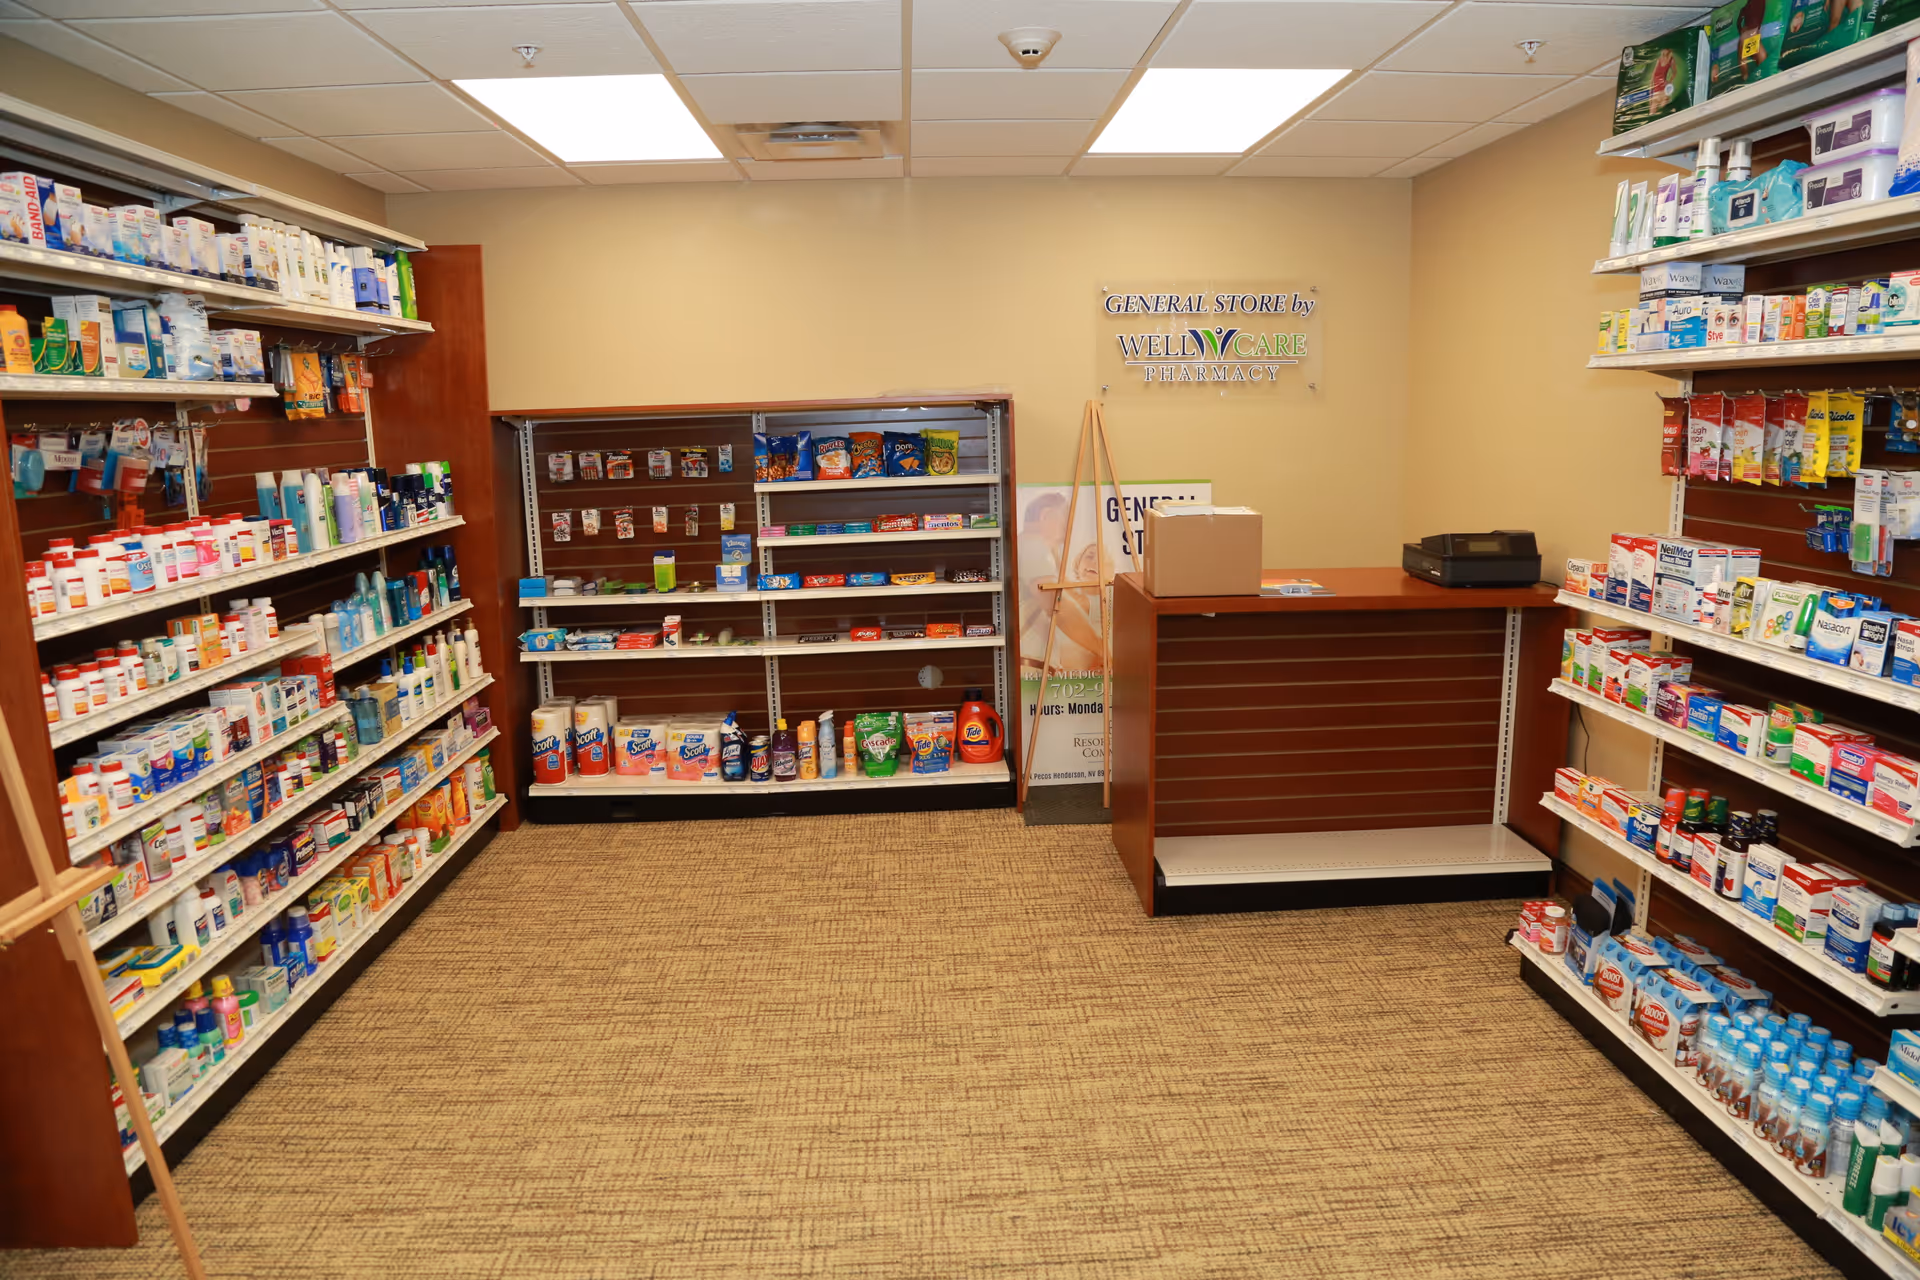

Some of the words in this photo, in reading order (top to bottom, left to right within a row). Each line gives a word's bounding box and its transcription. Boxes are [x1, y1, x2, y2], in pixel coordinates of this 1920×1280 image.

[24, 176, 44, 240] BAND-AID
[1105, 294, 1207, 313] GENERAL
[1214, 294, 1287, 313] STORE
[1291, 293, 1314, 317] by
[1672, 305, 1692, 316] Auro
[1707, 330, 1724, 342] Stye
[1233, 334, 1307, 356] CARE
[1144, 365, 1279, 382] PHARMACY
[1660, 544, 1693, 558] NeilMed
[1717, 588, 1730, 599] Afrin
[1817, 620, 1851, 635] Nasacort
[1862, 622, 1885, 633] Breathe
[1897, 636, 1914, 645] Nasal
[1896, 644, 1915, 653] Strips
[1068, 702, 1103, 715] Monda
[577, 728, 598, 746] Scott
[966, 727, 981, 738] Tide
[533, 736, 554, 753] Scott
[631, 739, 651, 753] Scott
[861, 738, 896, 748] Cascade
[916, 740, 931, 752] Tide
[684, 745, 705, 758] Scott
[752, 755, 768, 770] AJAX
[1053, 772, 1086, 780] Henderson,
[1749, 855, 1776, 873] Mucinex
[1834, 902, 1860, 922] Mucinex
[1602, 969, 1622, 983] BOOST
[1645, 1005, 1666, 1021] BOOST
[1850, 1147, 1865, 1188] BIOFREEZE
